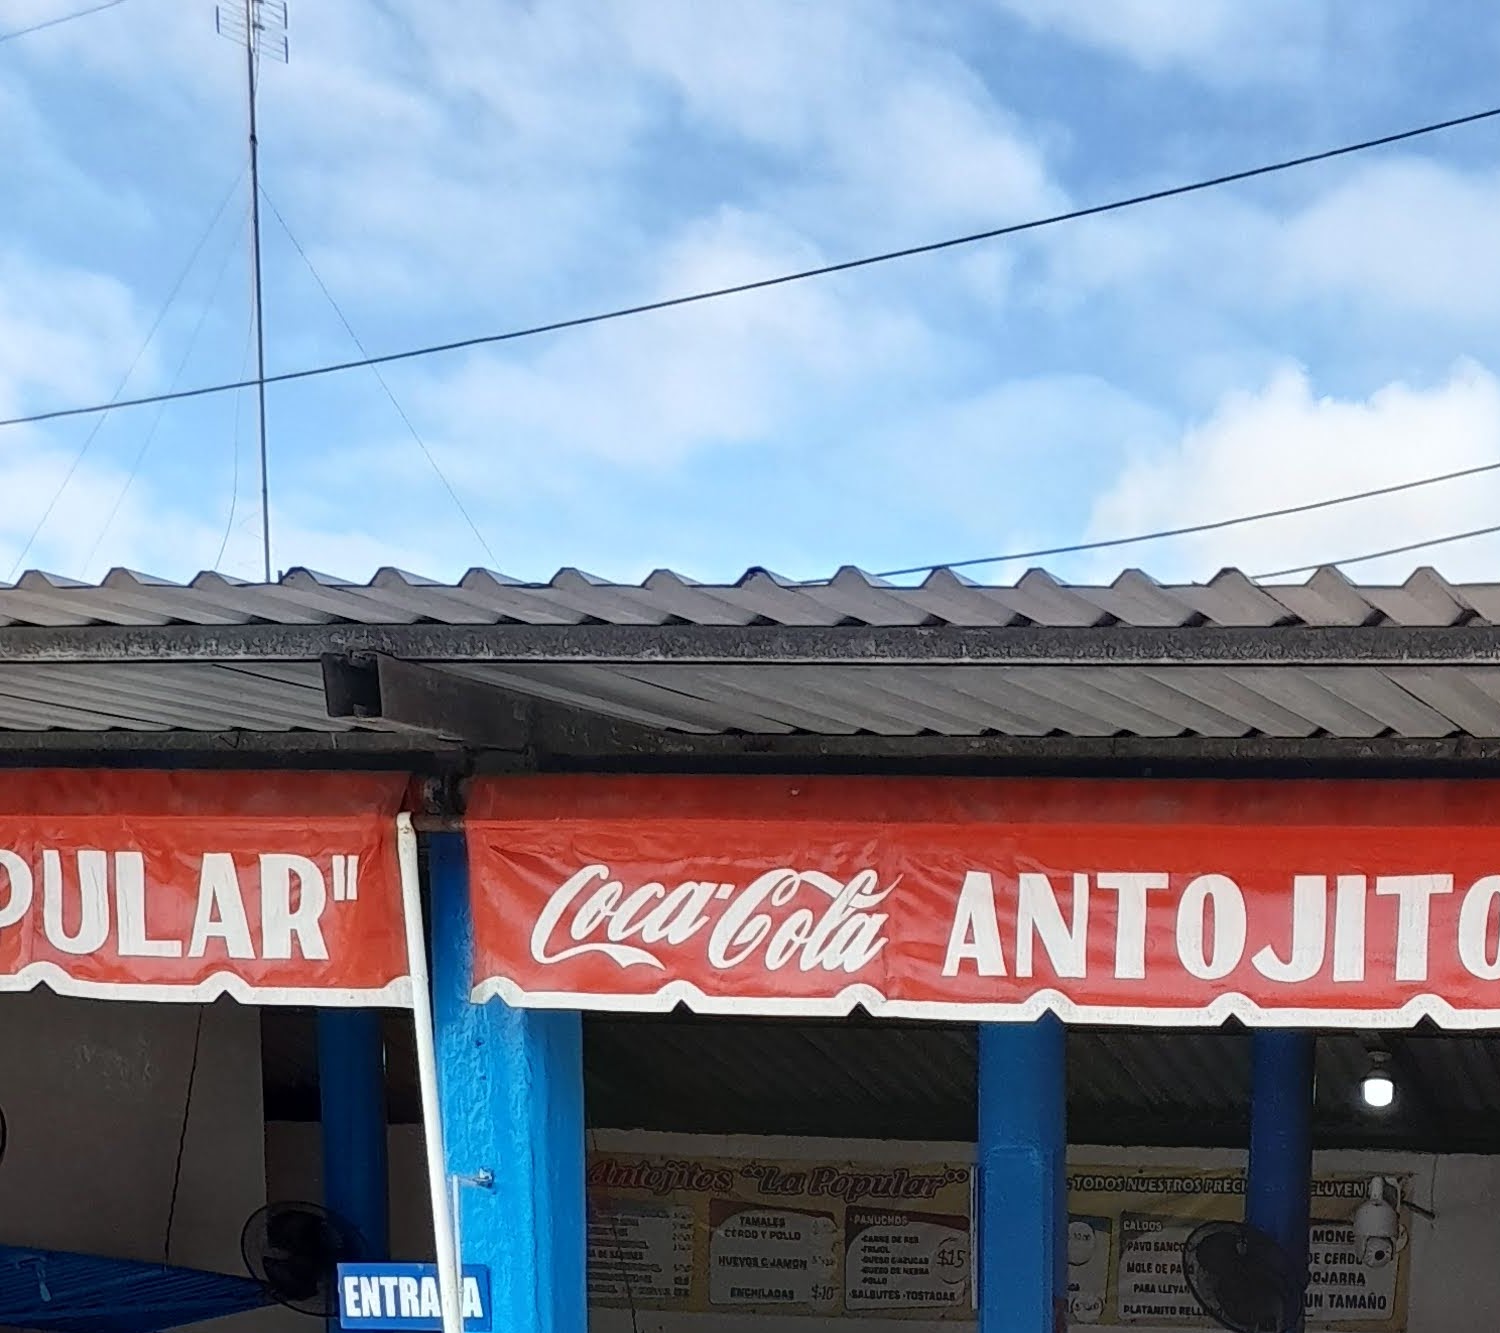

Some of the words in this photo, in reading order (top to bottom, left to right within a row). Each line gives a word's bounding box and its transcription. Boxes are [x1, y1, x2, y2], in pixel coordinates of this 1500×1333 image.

[530, 863, 904, 973] Coca-Cola
[1073, 1174, 1127, 1192] TODOS
[1127, 1175, 1203, 1193] NUESTROS
[1203, 1177, 1246, 1194] PRECI
[740, 1216, 786, 1227] TAMALES
[1123, 1219, 1163, 1232] CALDOS
[769, 1231, 801, 1241] POLLO
[1127, 1241, 1152, 1252] PAVO
[1126, 1262, 1153, 1274] MOLE
[1155, 1263, 1169, 1274] DE
[1312, 1271, 1366, 1285] OJARRA
[730, 1286, 795, 1300] ENCHILADAS
[1133, 1283, 1156, 1294] PARA
[343, 1276, 484, 1318] ENTRAA
[1328, 1290, 1387, 1310] TAMAÑO
